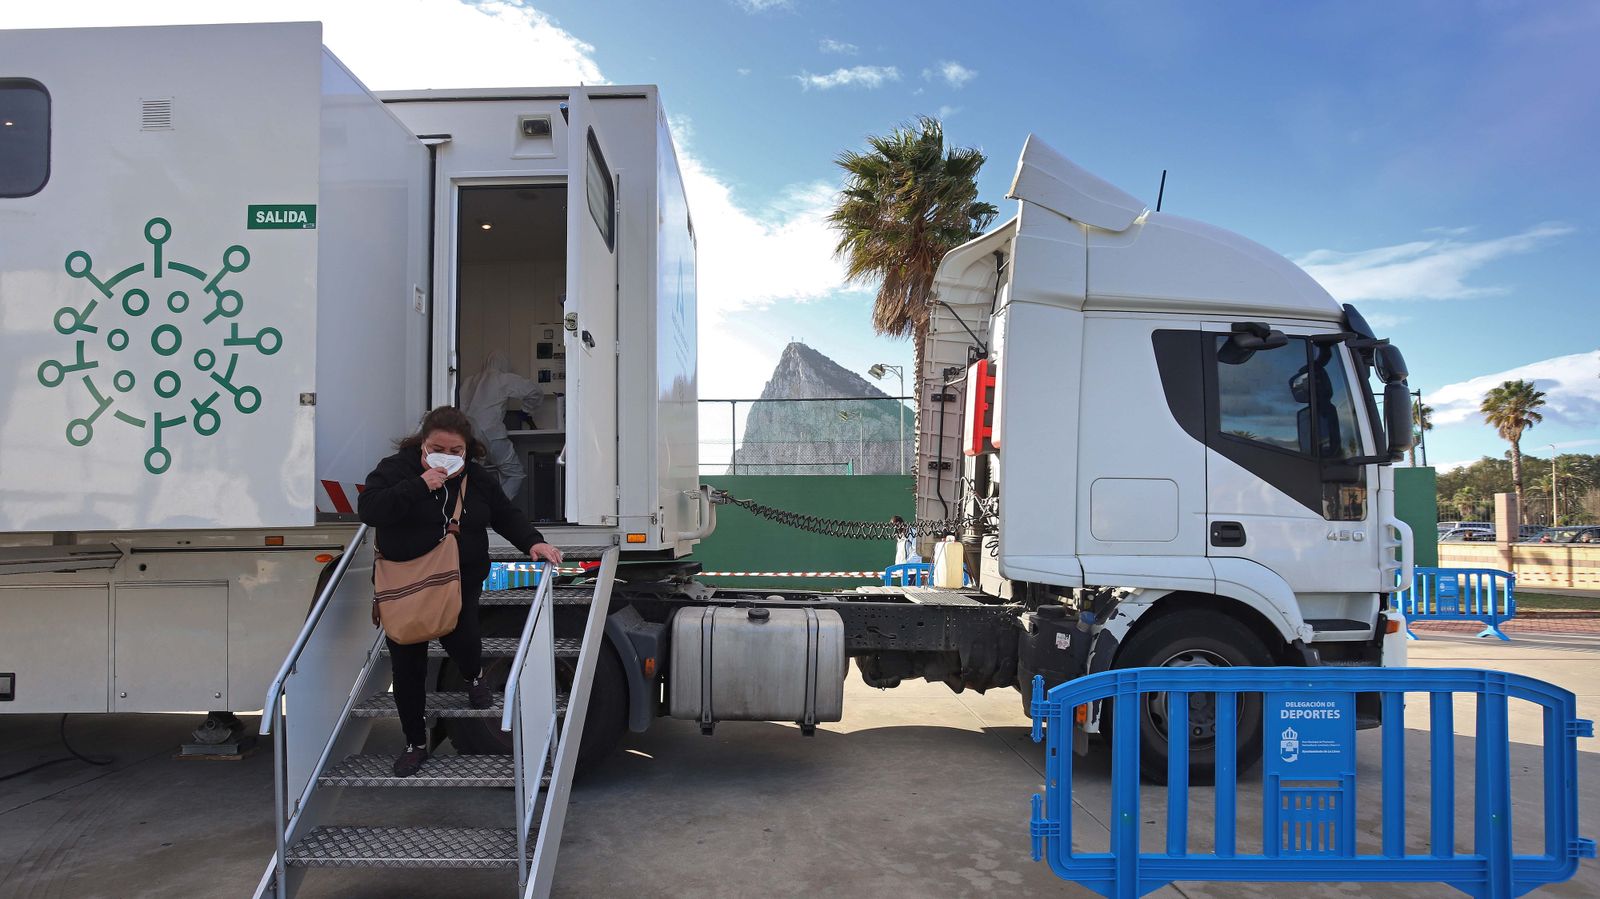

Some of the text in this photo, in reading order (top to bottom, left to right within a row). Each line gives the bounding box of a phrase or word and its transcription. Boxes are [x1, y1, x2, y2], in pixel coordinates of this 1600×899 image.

[256, 210, 307, 223] SALIDA
[1326, 529, 1364, 542] 450
[1280, 709, 1341, 719] DEPORTES
